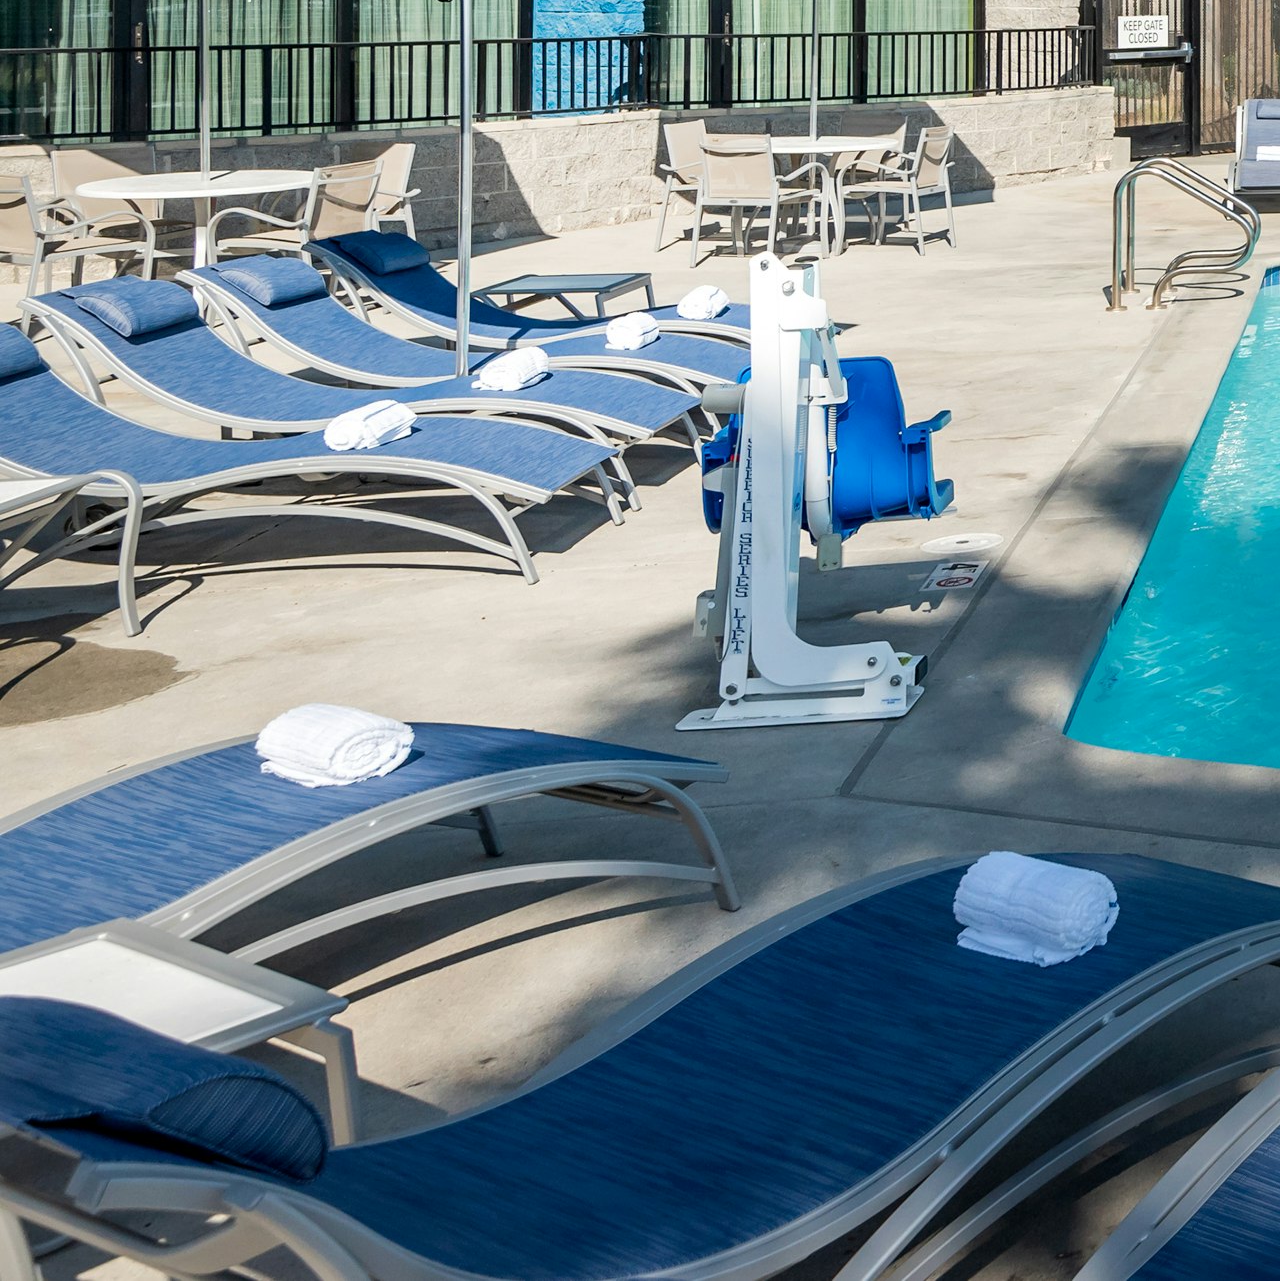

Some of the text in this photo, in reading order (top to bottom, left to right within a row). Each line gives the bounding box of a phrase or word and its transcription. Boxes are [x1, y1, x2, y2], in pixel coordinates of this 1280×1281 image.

[1123, 19, 1163, 31] KEEP GATE
[1129, 32, 1158, 44] CLOSED
[735, 533, 752, 598] SERIES
[731, 607, 746, 651] LIFT
